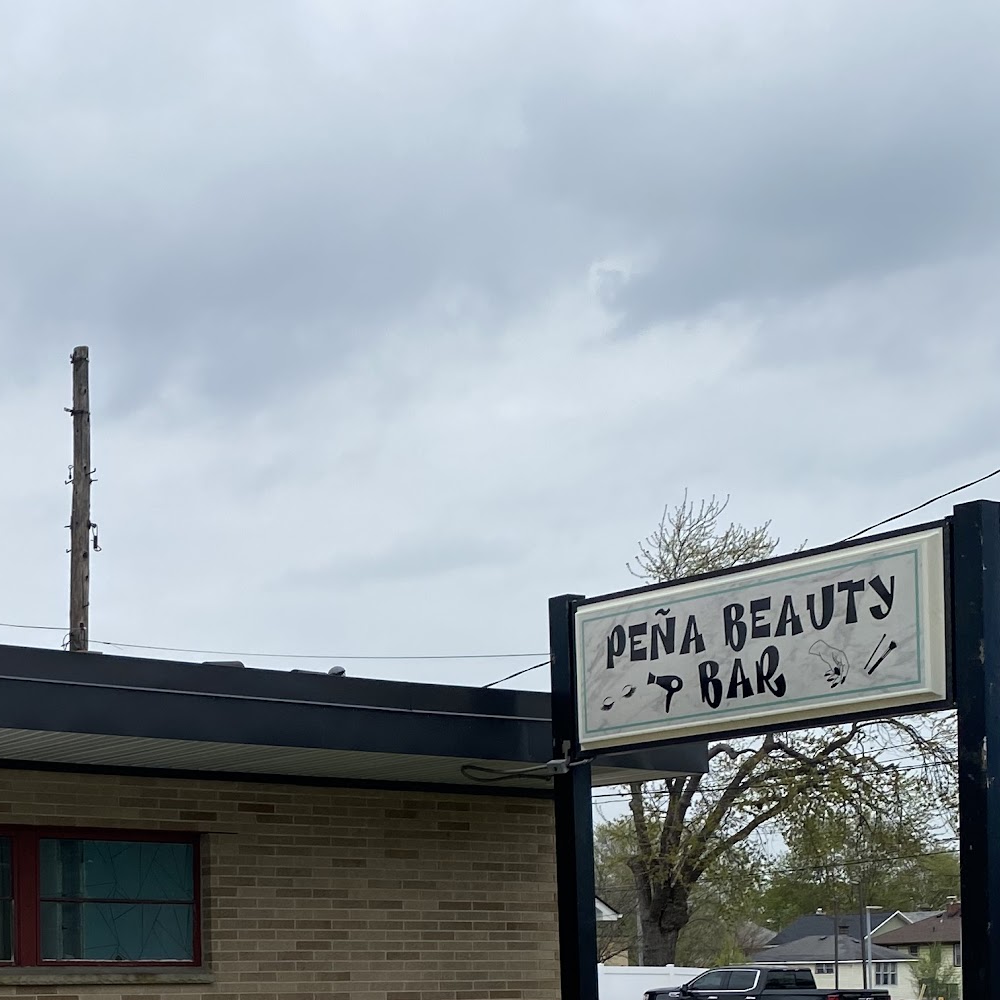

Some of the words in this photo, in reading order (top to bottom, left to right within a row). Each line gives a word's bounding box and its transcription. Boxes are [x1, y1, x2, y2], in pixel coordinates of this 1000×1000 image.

[606, 608, 706, 669] PEÑA
[723, 575, 895, 652] BEAUTY
[699, 645, 787, 709] BAR
